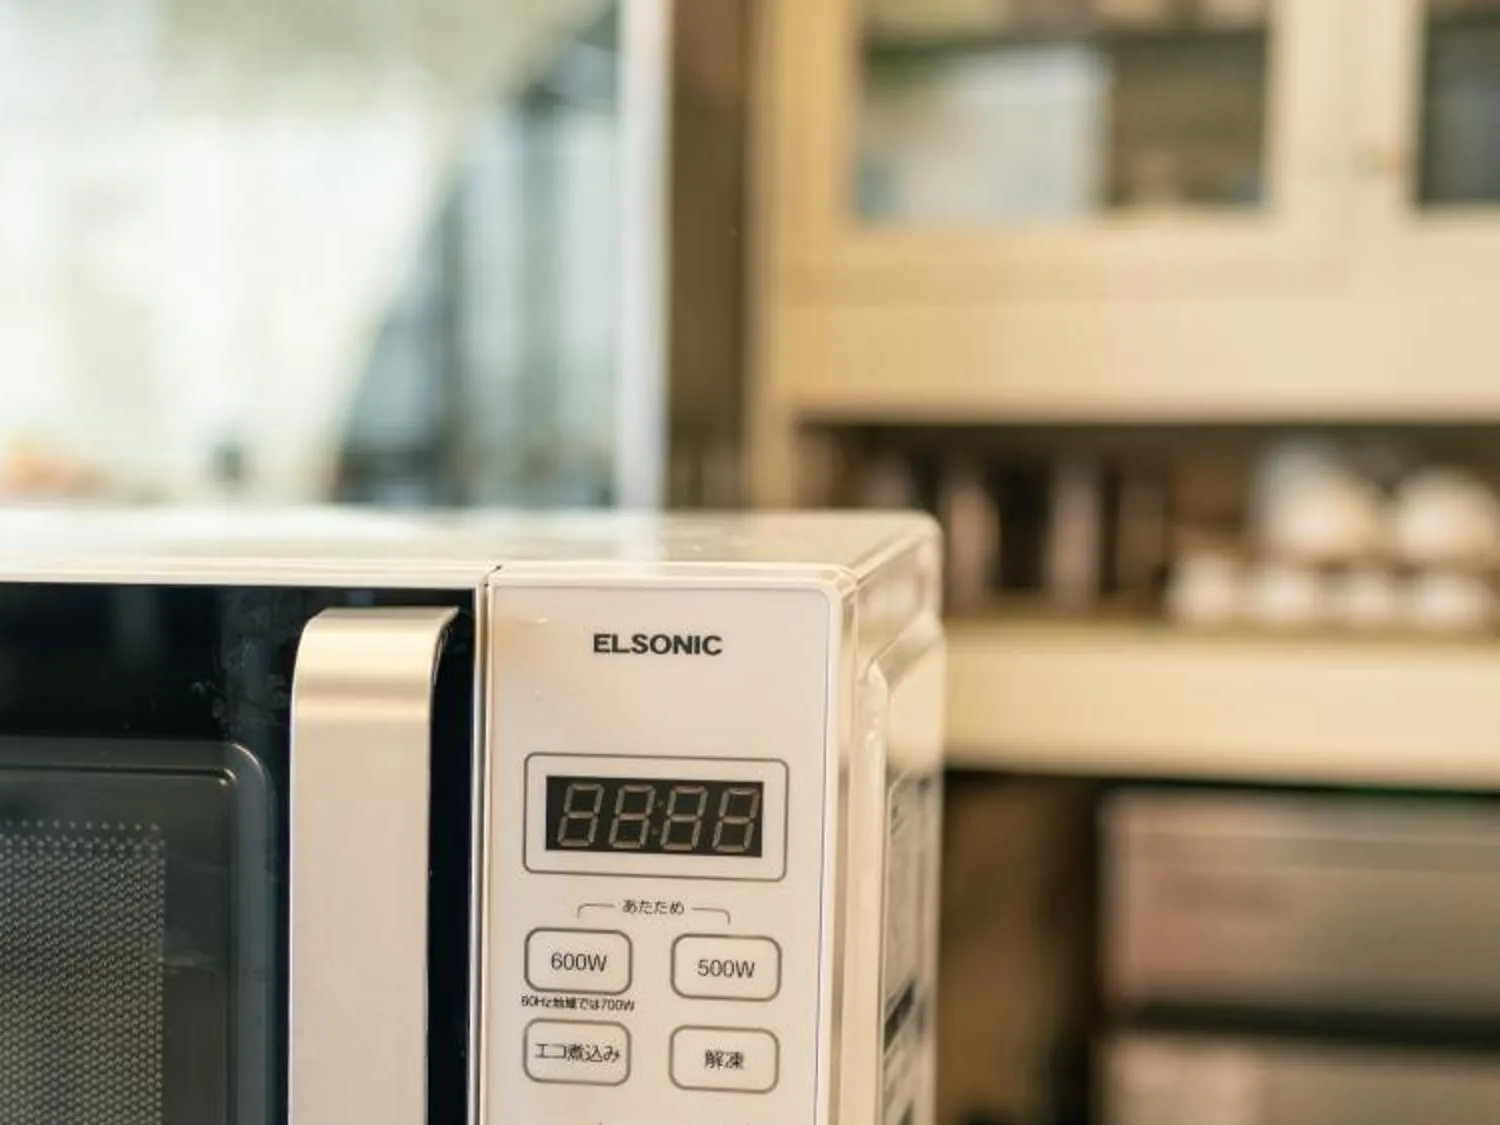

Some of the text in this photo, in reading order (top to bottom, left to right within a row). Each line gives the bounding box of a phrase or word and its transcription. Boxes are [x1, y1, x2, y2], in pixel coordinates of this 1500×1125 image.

[593, 633, 723, 655] ELSONIC
[622, 900, 685, 915] あたため
[550, 952, 608, 972] 600W
[697, 959, 756, 978] 500W
[704, 1050, 745, 1069] 解凍
